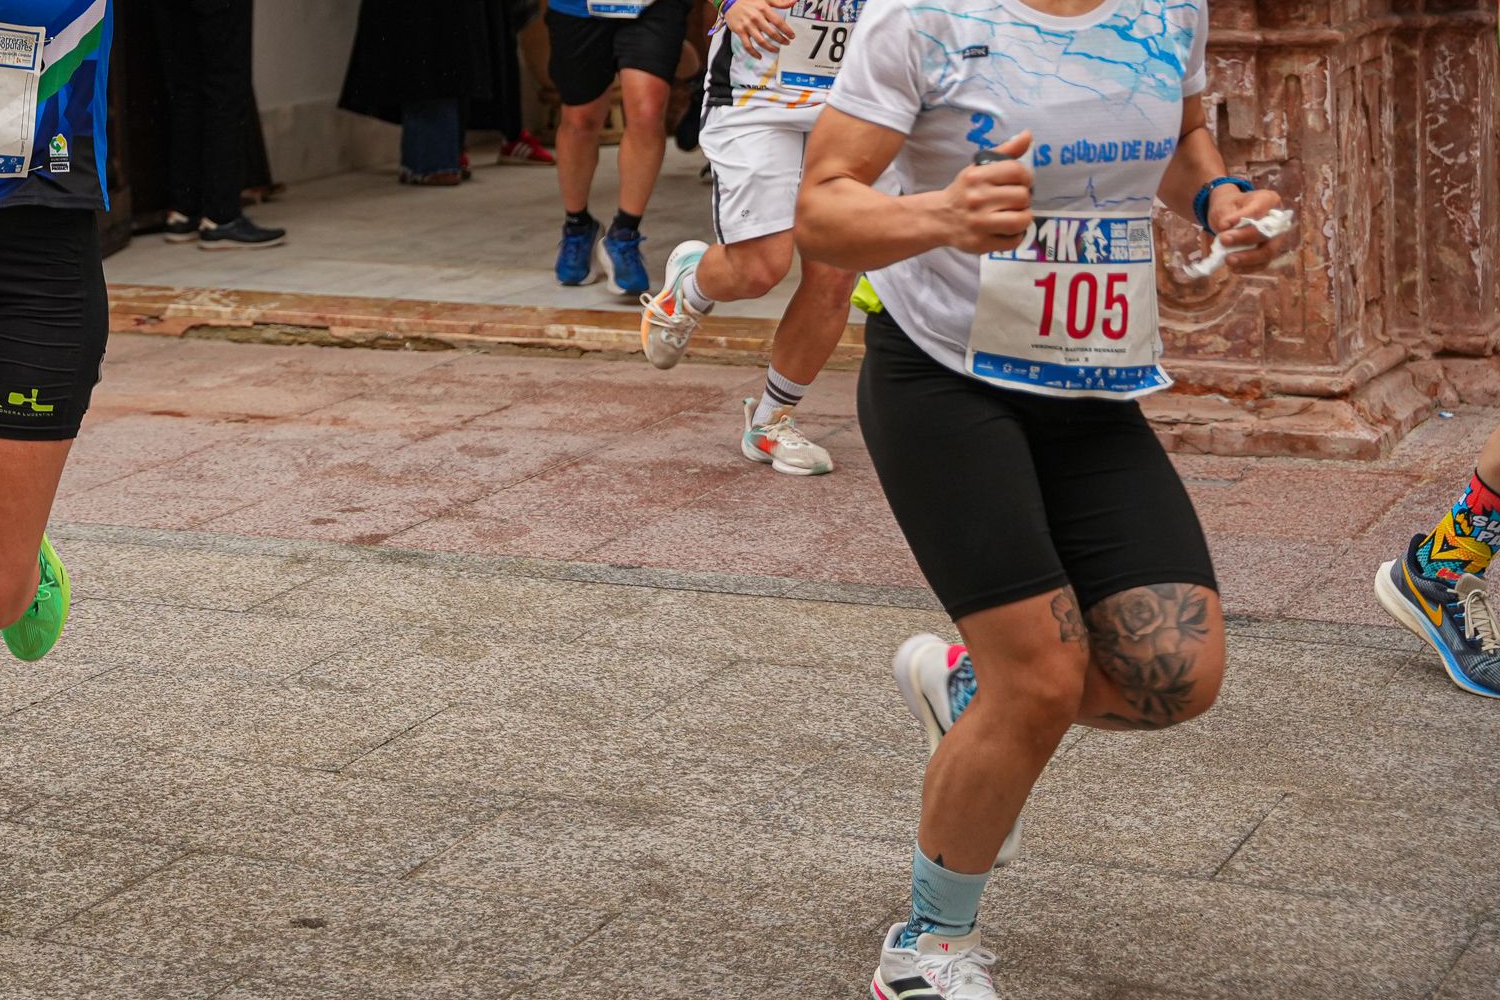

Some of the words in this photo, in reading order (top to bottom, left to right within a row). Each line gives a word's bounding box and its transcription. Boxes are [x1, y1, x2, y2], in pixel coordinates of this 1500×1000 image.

[808, 25, 853, 63] 78
[1060, 139, 1119, 166] CIUDAD
[1121, 140, 1143, 162] DE
[1034, 271, 1129, 340] 105
